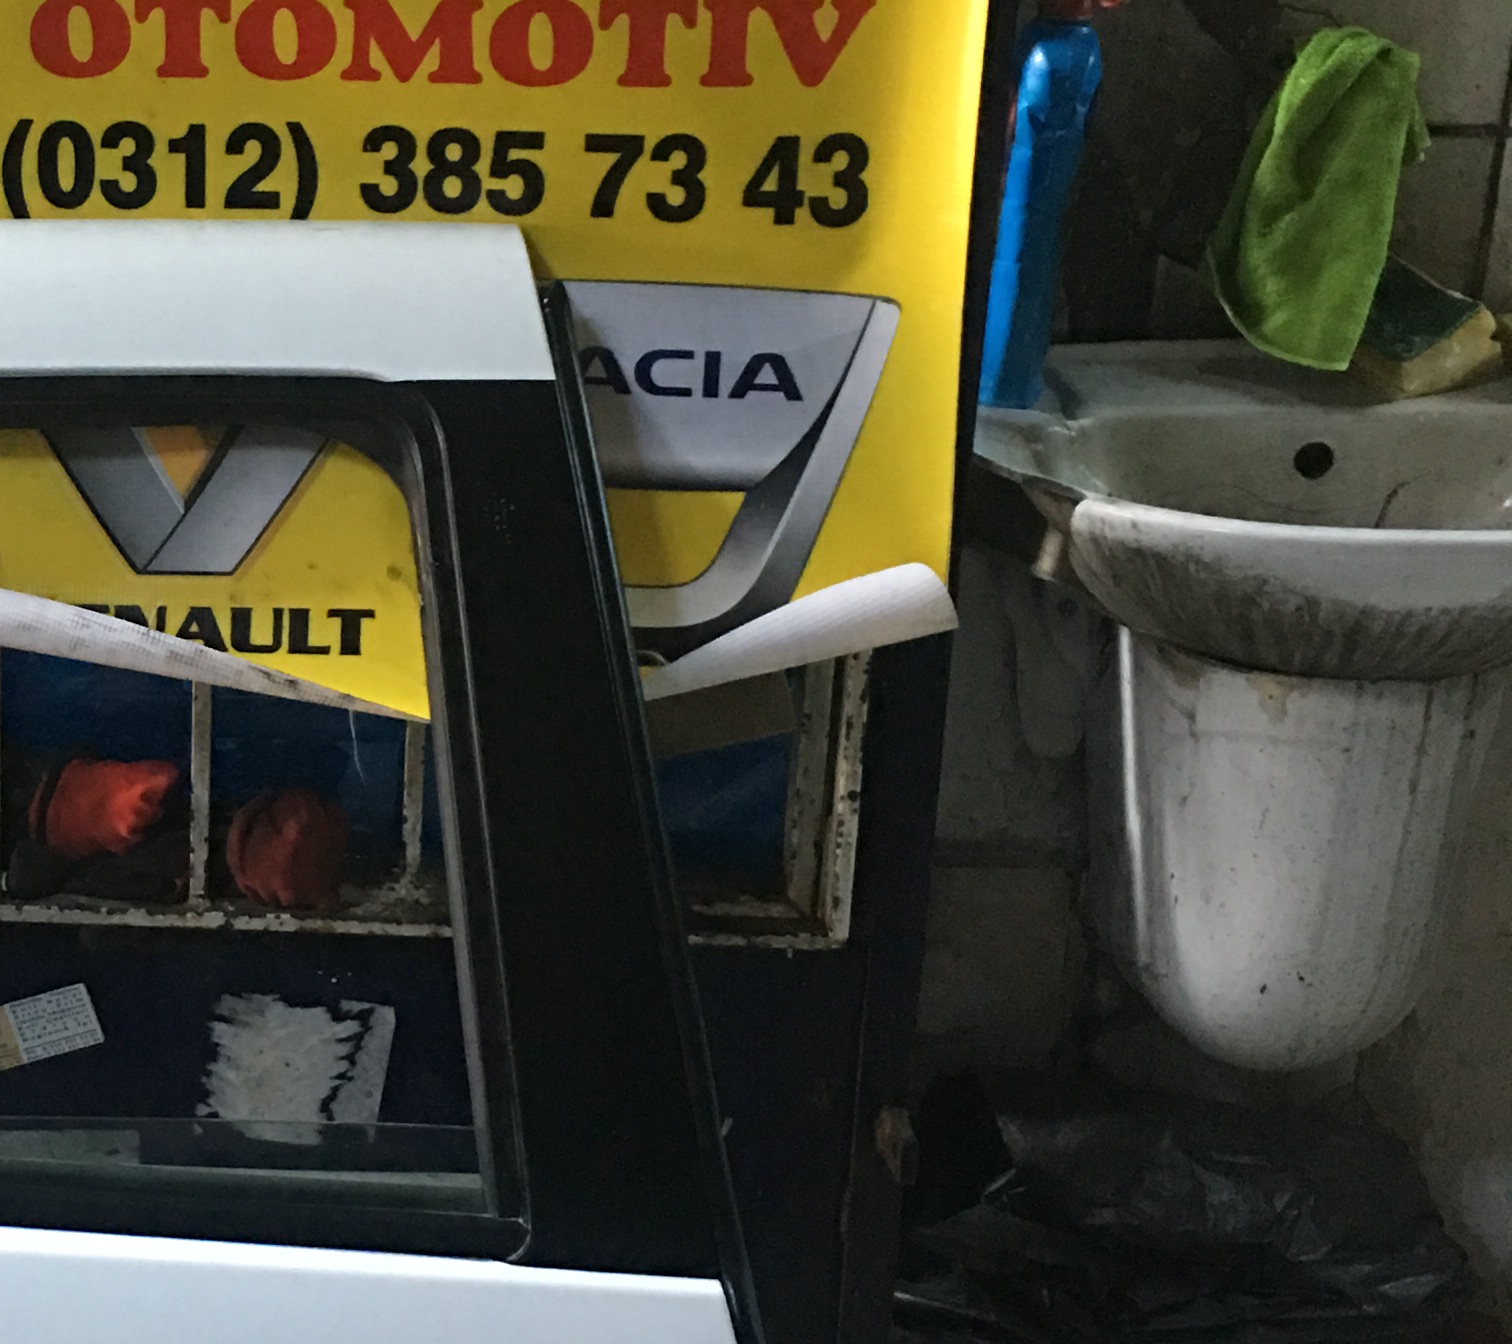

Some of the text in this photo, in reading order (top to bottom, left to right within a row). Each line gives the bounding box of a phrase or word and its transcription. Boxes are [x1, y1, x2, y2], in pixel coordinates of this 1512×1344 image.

[1, 118, 870, 229] (0312) 385 73 43
